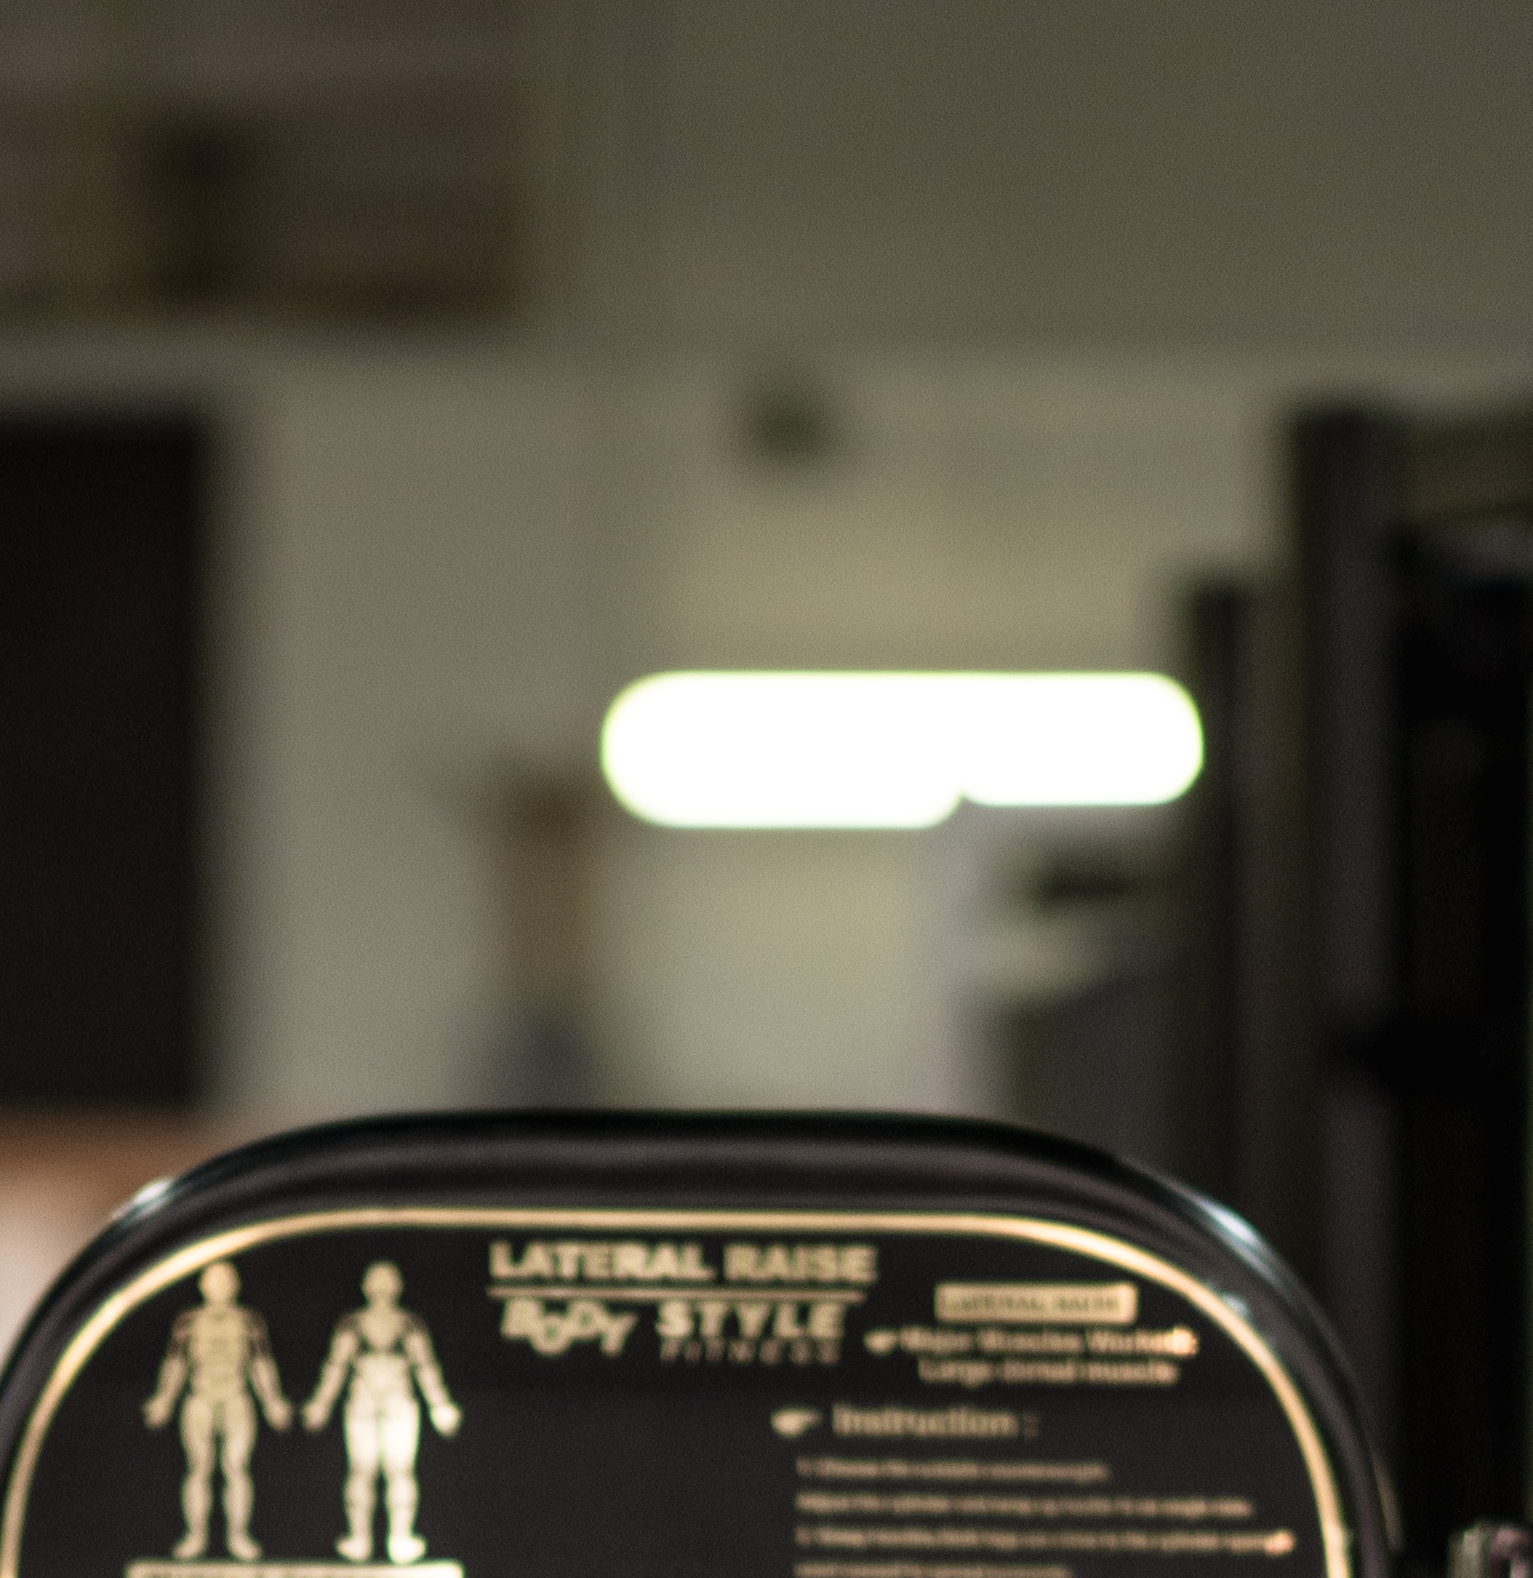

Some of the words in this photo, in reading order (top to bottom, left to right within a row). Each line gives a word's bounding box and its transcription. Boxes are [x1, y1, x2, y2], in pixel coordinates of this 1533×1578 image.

[489, 1241, 716, 1280] LATERAL
[722, 1244, 878, 1283] RAISE
[656, 1299, 849, 1340] STYLE
[831, 1404, 1020, 1438] Instruction
